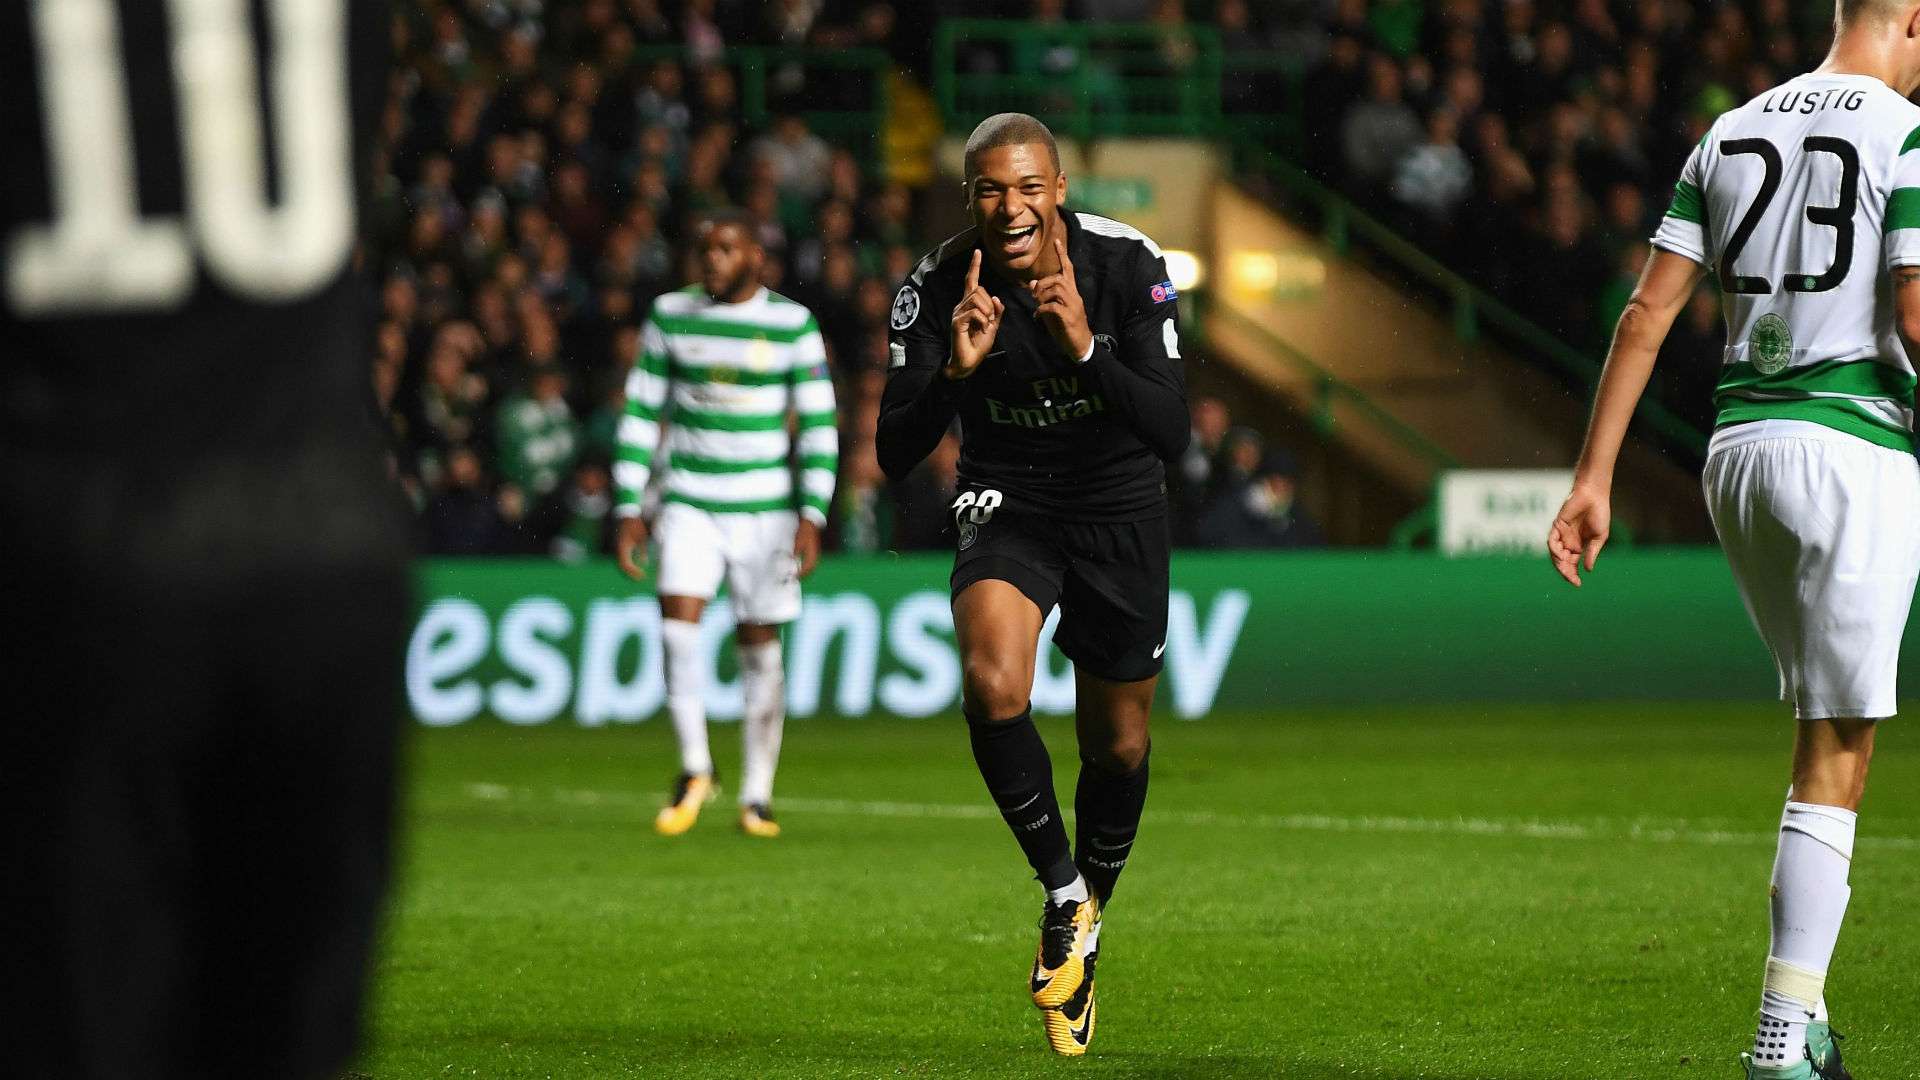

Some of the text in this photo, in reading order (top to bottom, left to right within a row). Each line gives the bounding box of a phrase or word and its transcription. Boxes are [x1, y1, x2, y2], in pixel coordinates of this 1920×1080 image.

[4, 0, 357, 316] 10
[1763, 88, 1867, 115] LUSTIG
[1719, 135, 1860, 295] 23
